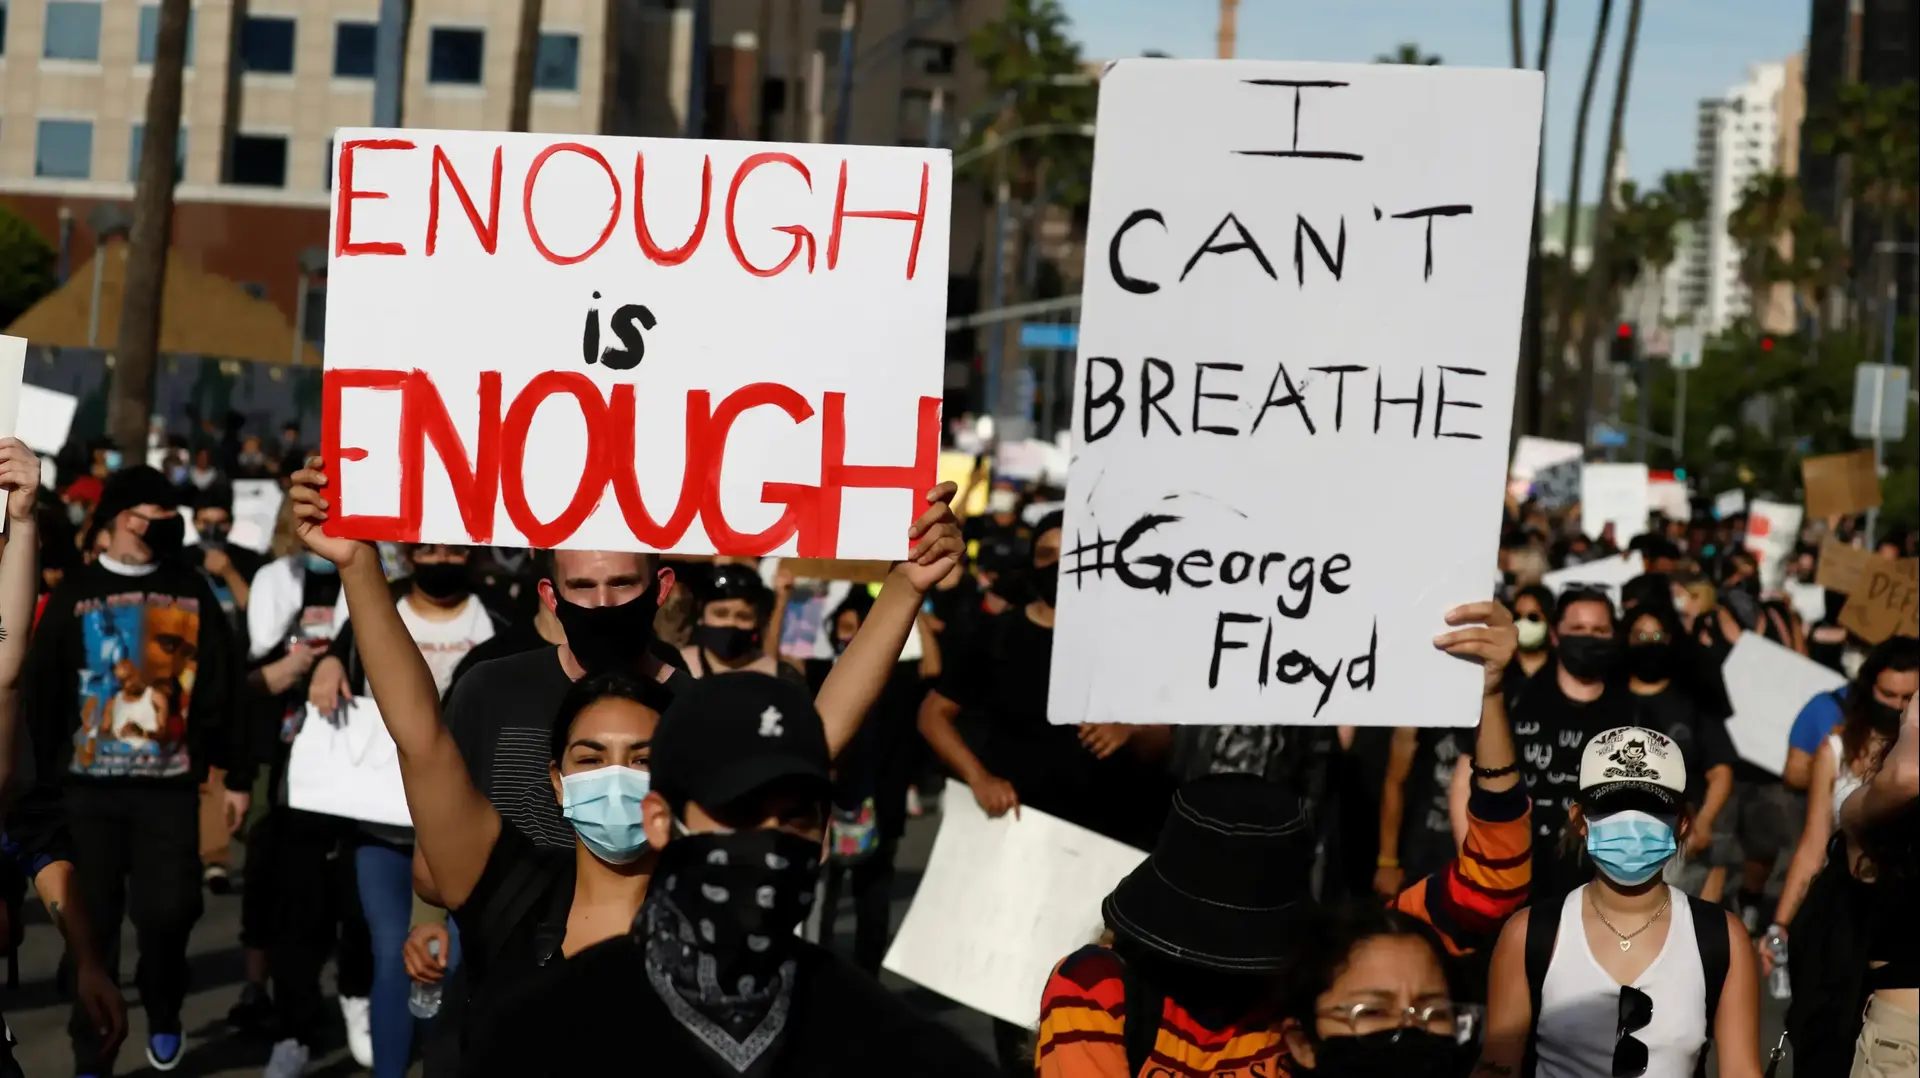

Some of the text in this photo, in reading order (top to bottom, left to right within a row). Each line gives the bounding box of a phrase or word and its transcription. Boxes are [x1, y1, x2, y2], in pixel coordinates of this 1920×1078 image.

[1230, 79, 1364, 162] I
[335, 139, 930, 281] ENOUGH
[1109, 204, 1473, 295] CAN'T
[582, 290, 658, 371] is
[1083, 356, 1487, 444] BREATHE
[321, 367, 944, 558] ENOUGH
[1063, 512, 1352, 619] #George
[1208, 610, 1378, 719] Floyd
